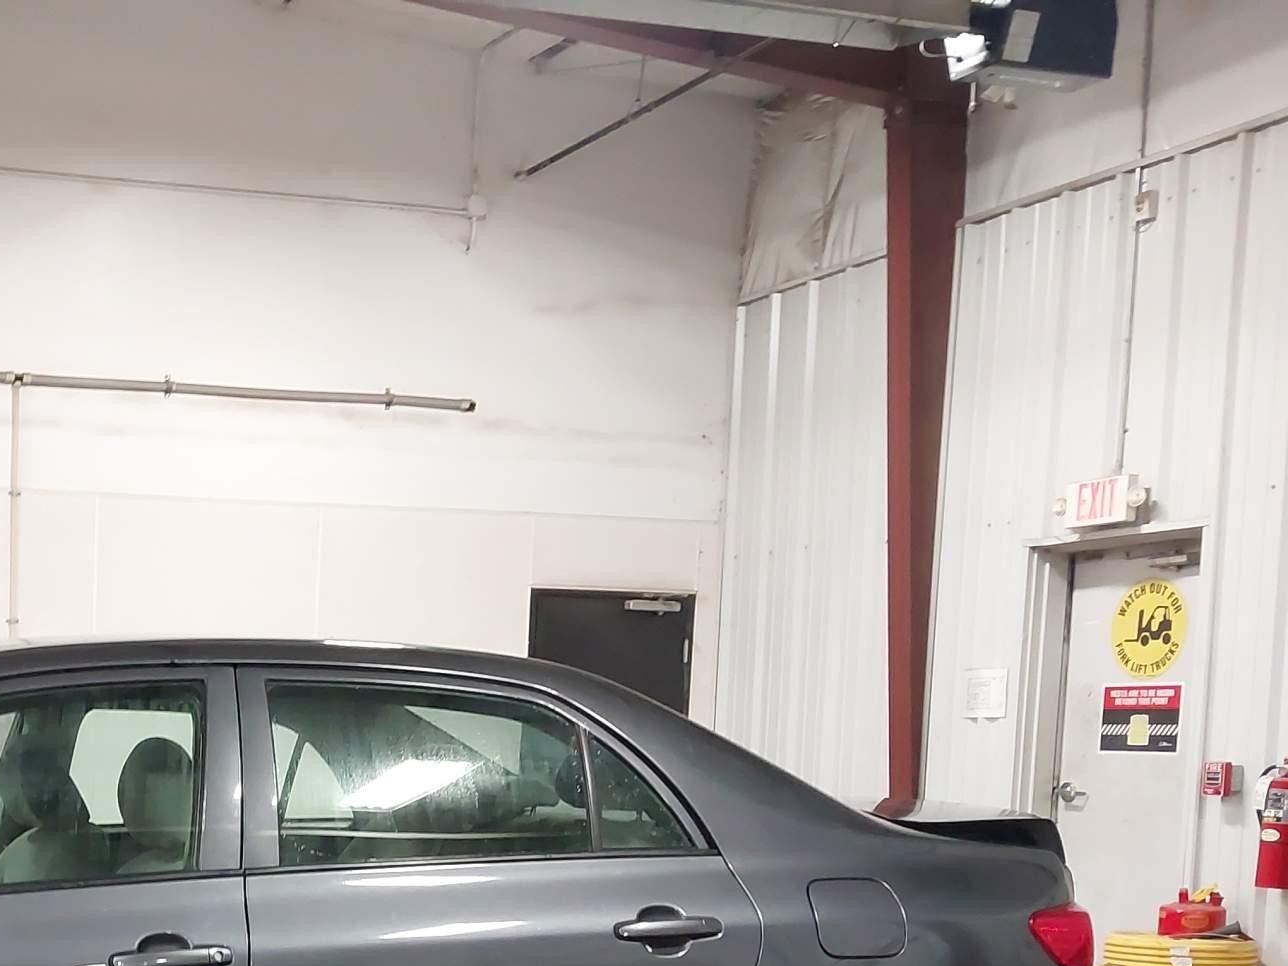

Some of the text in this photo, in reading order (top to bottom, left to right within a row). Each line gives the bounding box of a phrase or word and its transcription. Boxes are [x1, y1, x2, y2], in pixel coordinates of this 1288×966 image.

[1077, 479, 1119, 521] EXIT
[1118, 582, 1183, 617] WATCH OUT FOR
[1115, 641, 1180, 674] FORK LIFT TRUCKS
